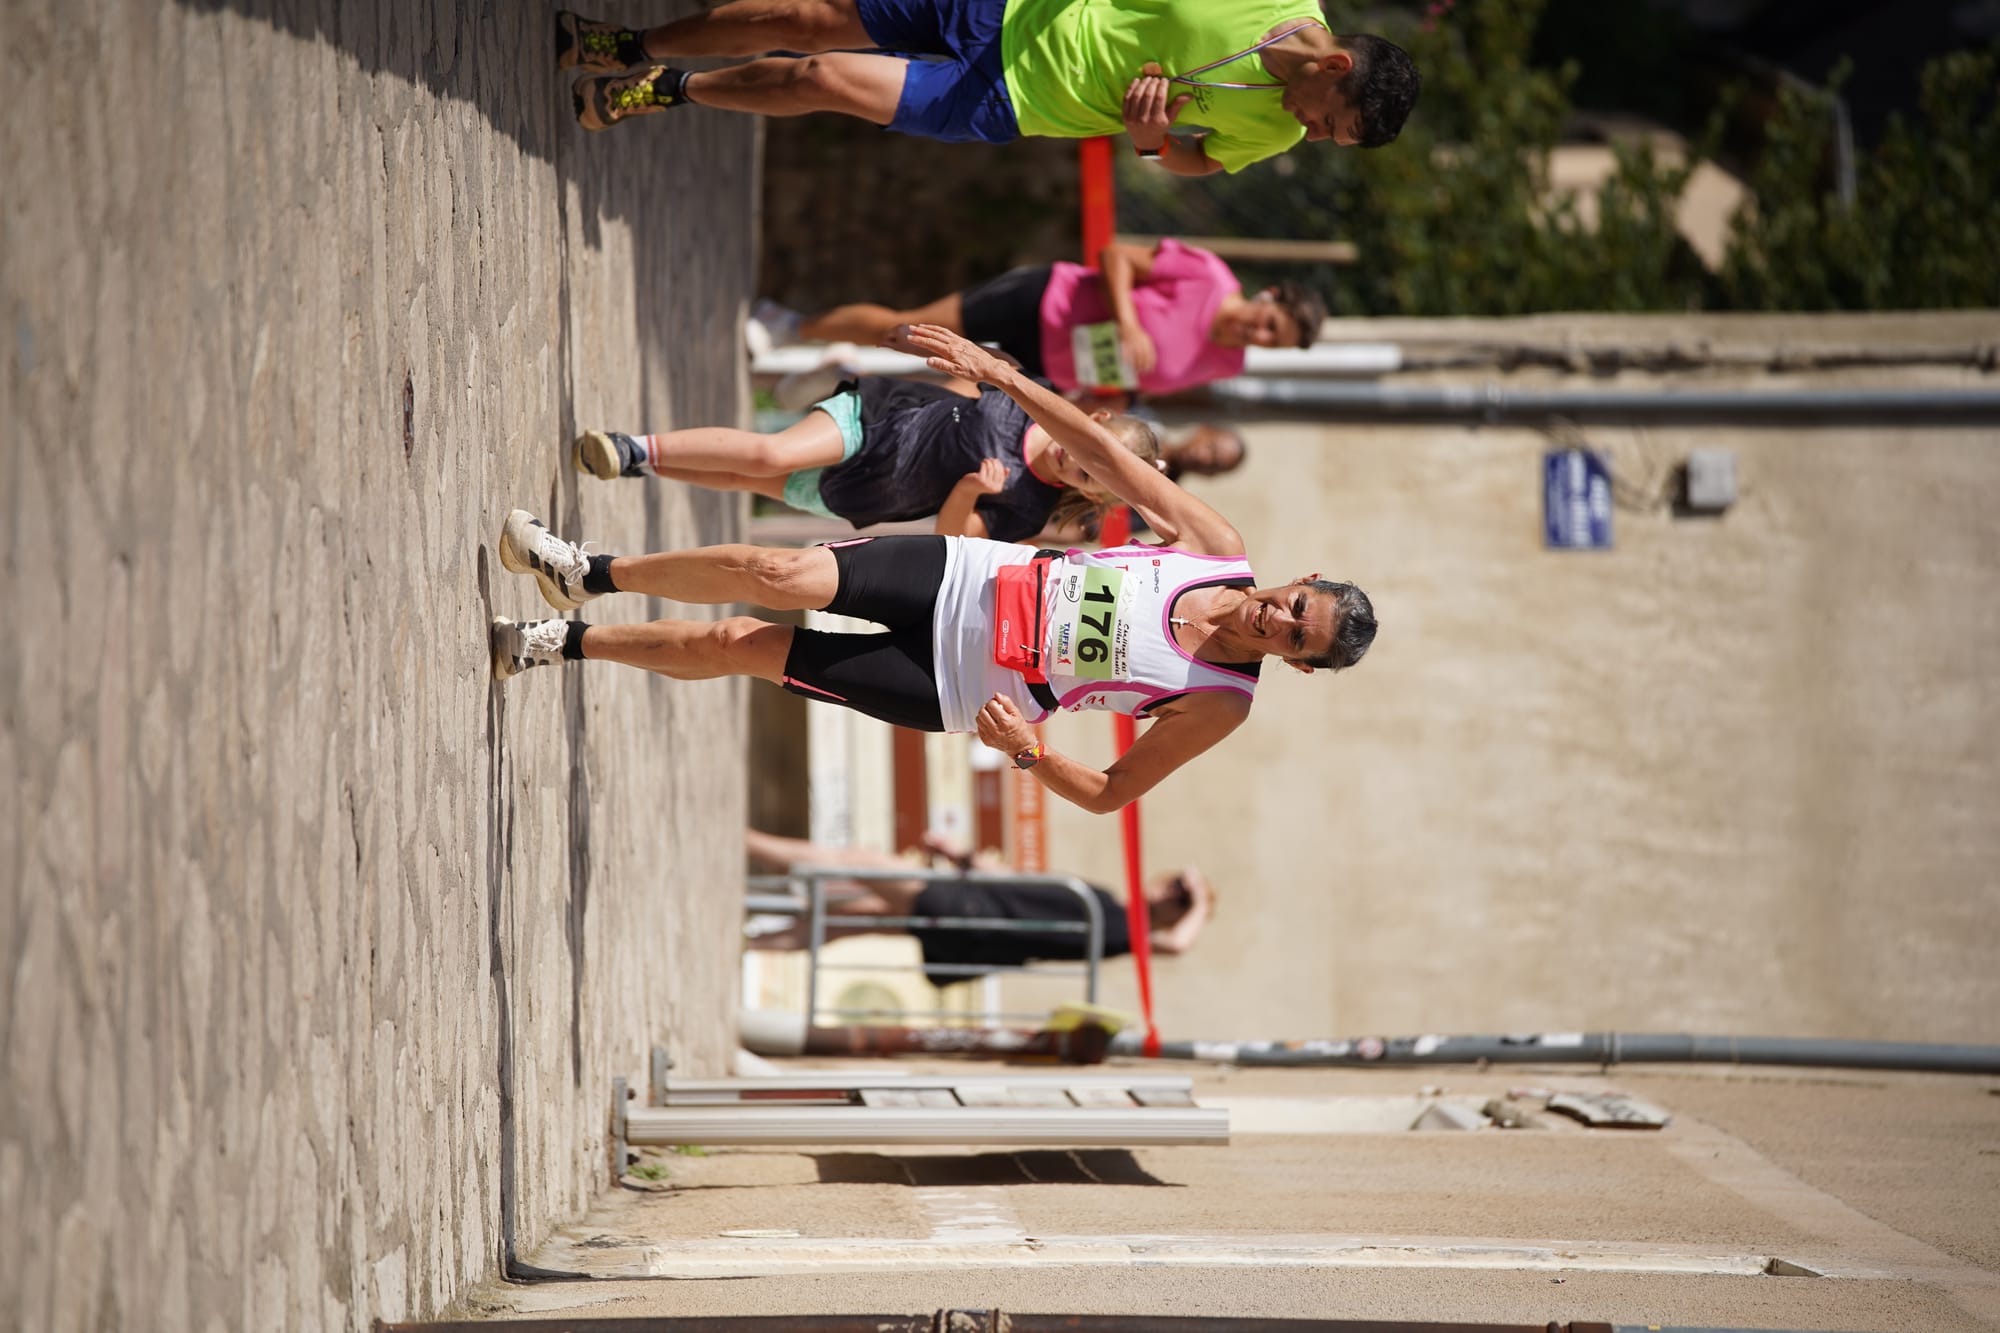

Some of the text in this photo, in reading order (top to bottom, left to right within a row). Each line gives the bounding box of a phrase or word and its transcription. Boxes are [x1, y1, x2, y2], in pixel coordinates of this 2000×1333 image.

[1068, 575, 1078, 599] BFP
[1061, 622, 1071, 655] TUFF'S
[1077, 585, 1115, 663] 176
[1119, 623, 1130, 658] Challenge
